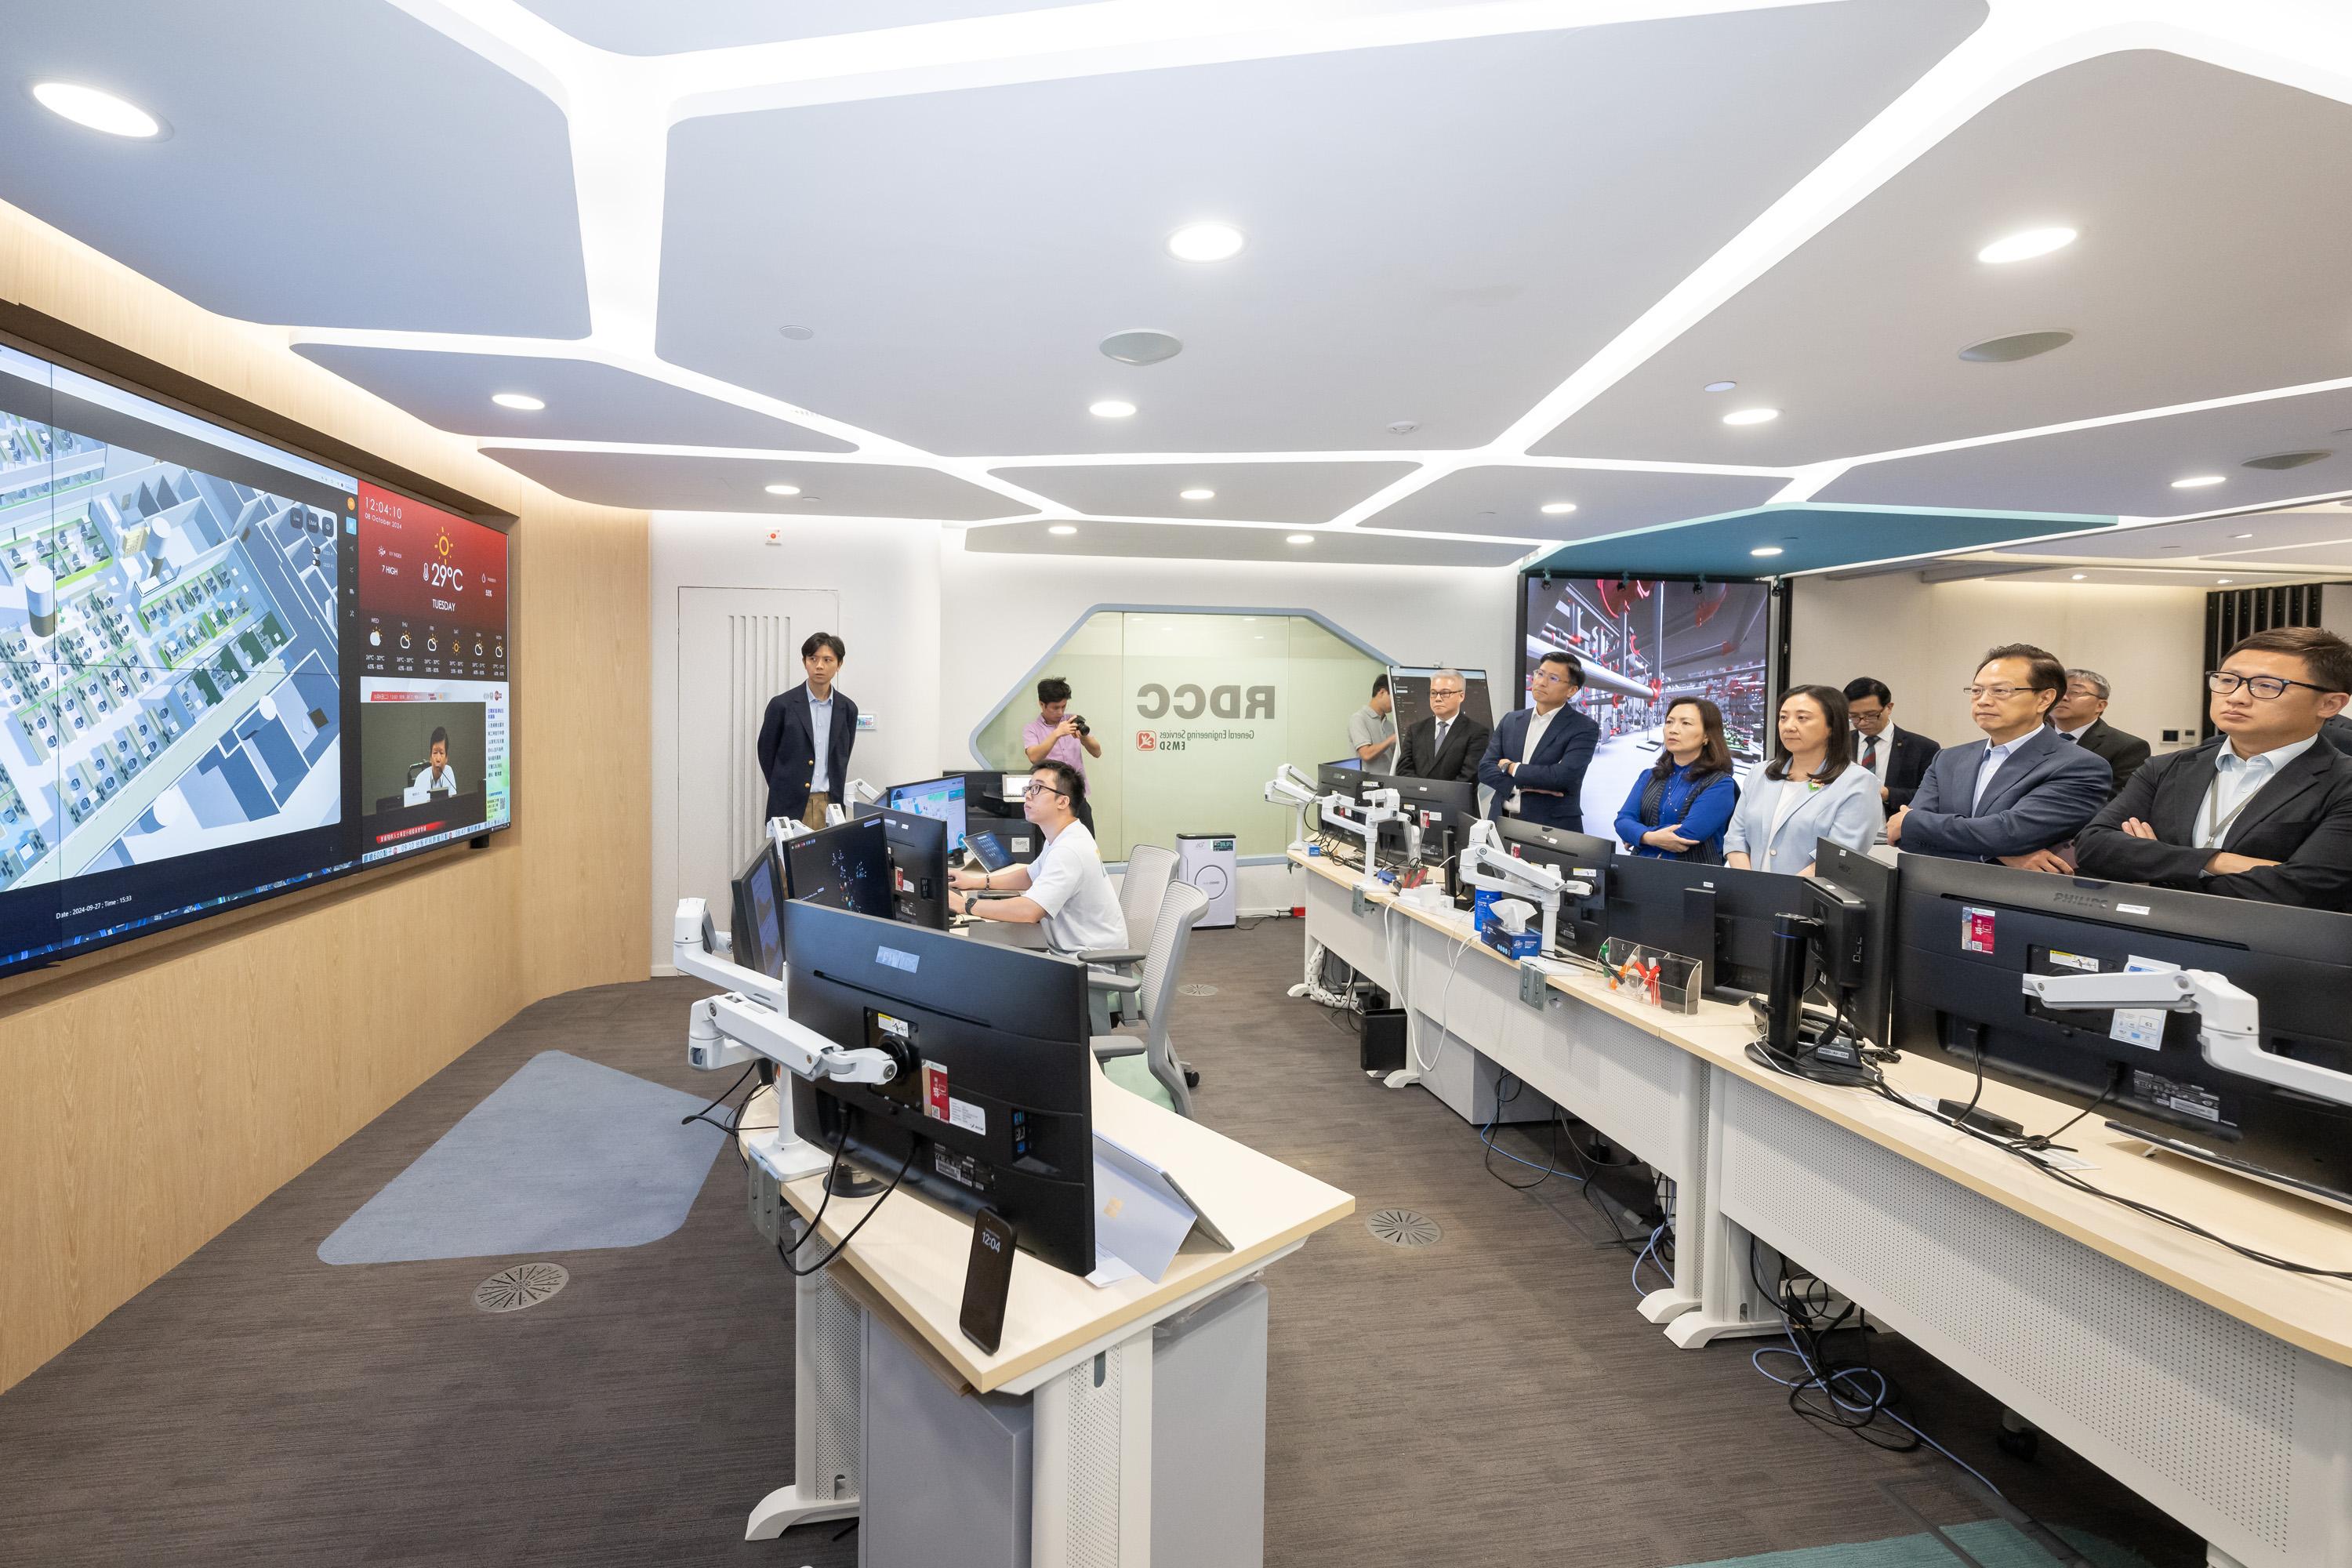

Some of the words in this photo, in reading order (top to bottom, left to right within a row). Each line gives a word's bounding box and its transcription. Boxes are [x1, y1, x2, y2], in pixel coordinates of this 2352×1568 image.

[365, 497, 402, 520] 12:04:10
[372, 514, 391, 526] October
[386, 566, 398, 575] HIGH
[431, 563, 463, 591] 29°C
[432, 598, 456, 612] TUESDAY
[56, 911, 69, 920] Date
[72, 902, 101, 915] 2024-09-27
[119, 895, 132, 904] 15:33
[982, 1231, 1000, 1254] 12:04
